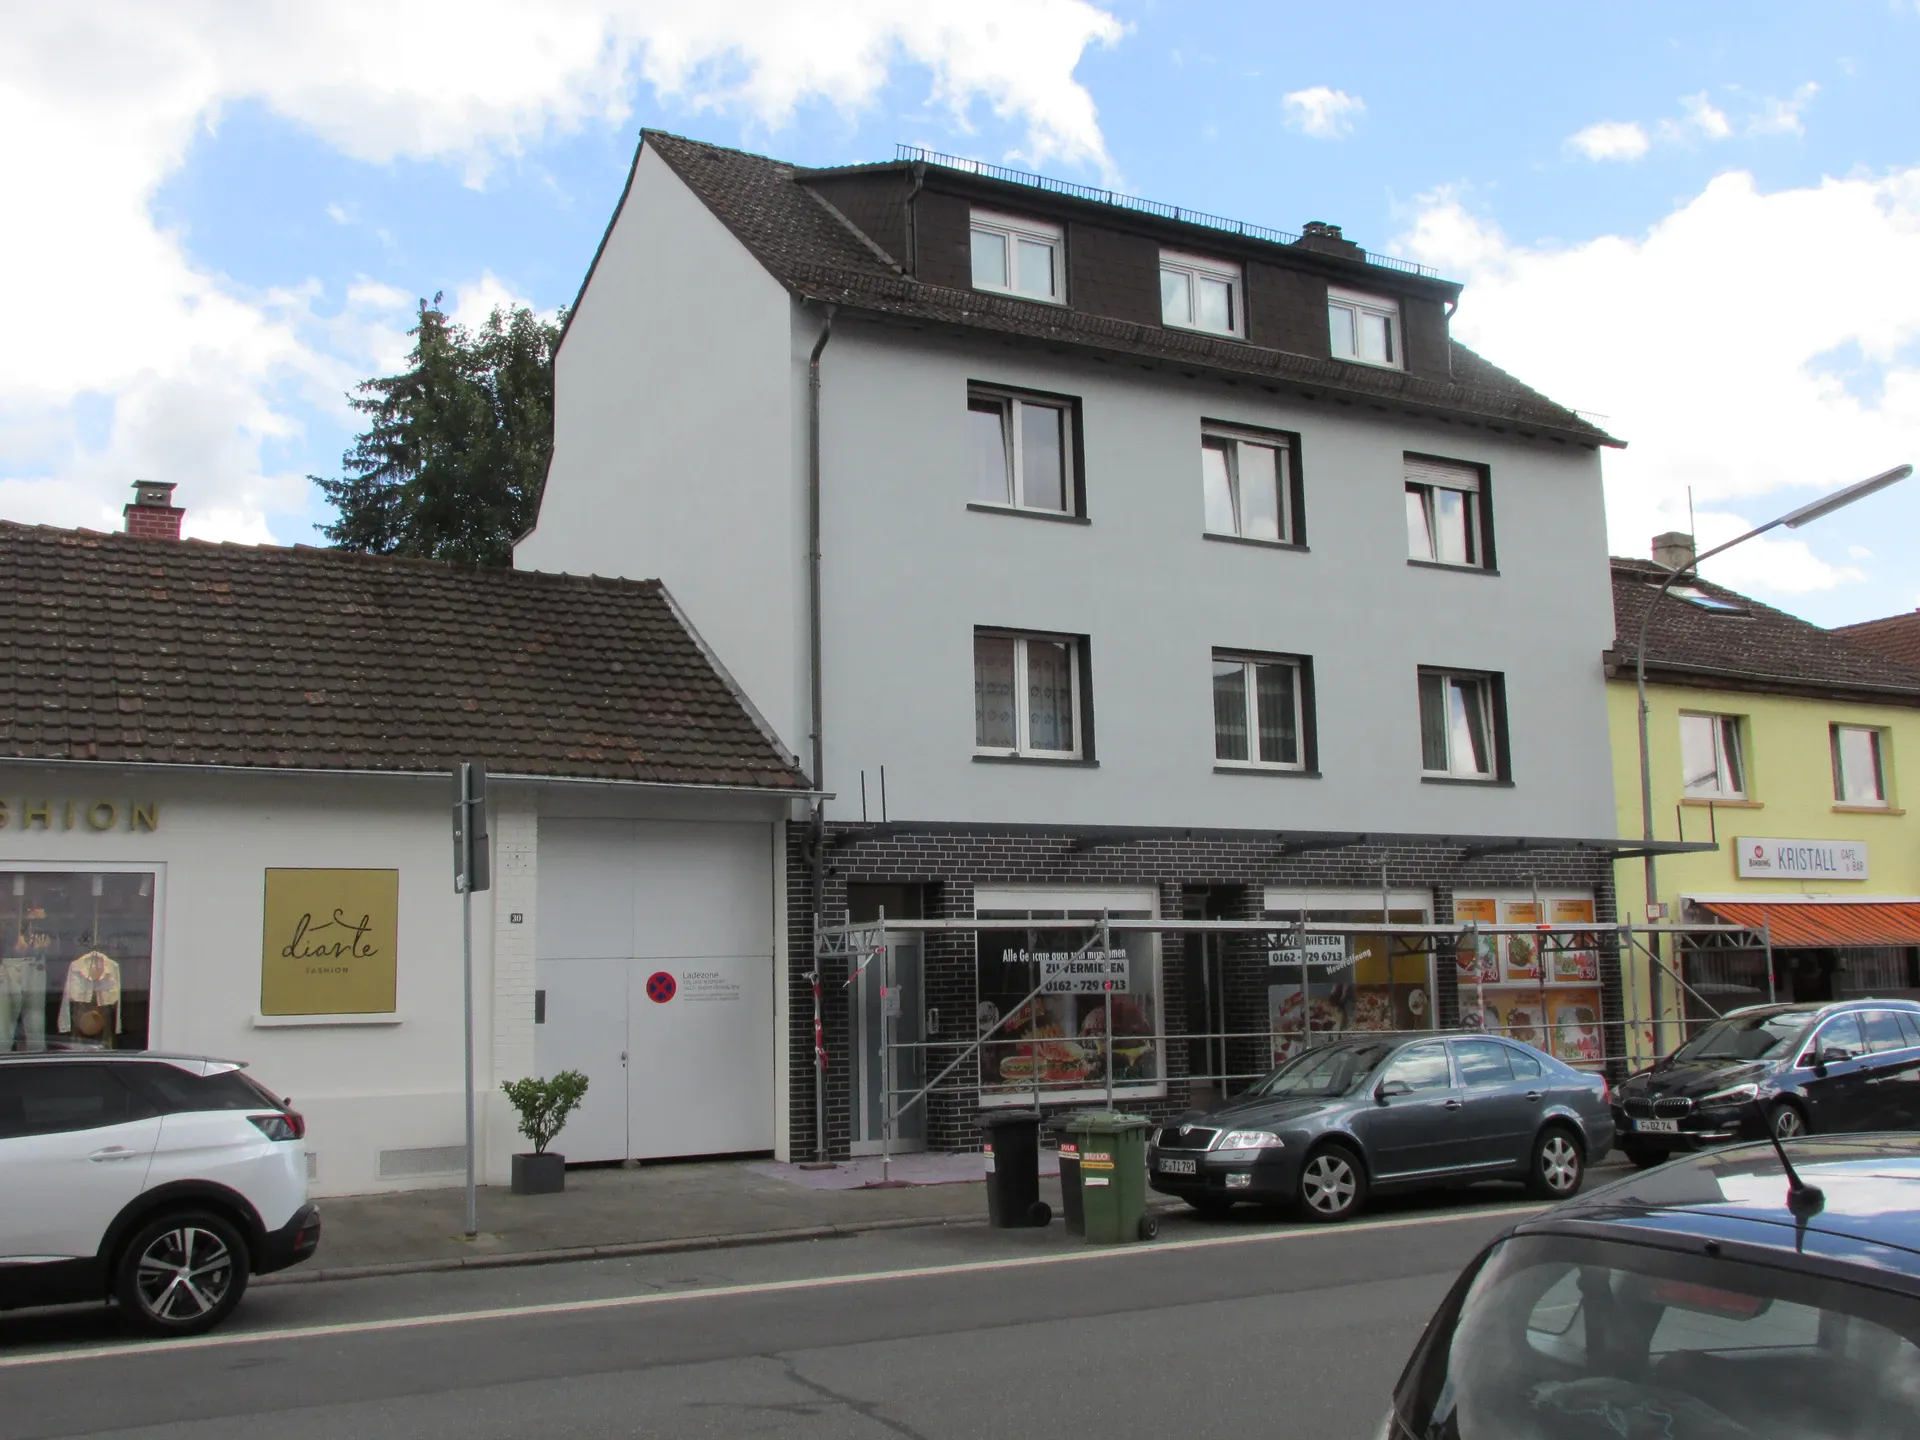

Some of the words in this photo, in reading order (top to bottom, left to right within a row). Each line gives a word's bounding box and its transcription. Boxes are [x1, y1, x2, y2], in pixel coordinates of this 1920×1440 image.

[1777, 847, 1837, 871] KRISTALL
[1852, 860, 1864, 872] BAR
[1002, 948, 1017, 962] Alle
[1019, 948, 1050, 962] Geichte
[1272, 952, 1296, 963] 0162
[1321, 951, 1343, 962] 6713
[1064, 962, 1125, 974] VERMIEEN
[1045, 981, 1072, 992] 0162
[1080, 980, 1099, 991] 729
[1083, 1152, 1109, 1161] SULO
[1182, 1161, 1196, 1173] 791
